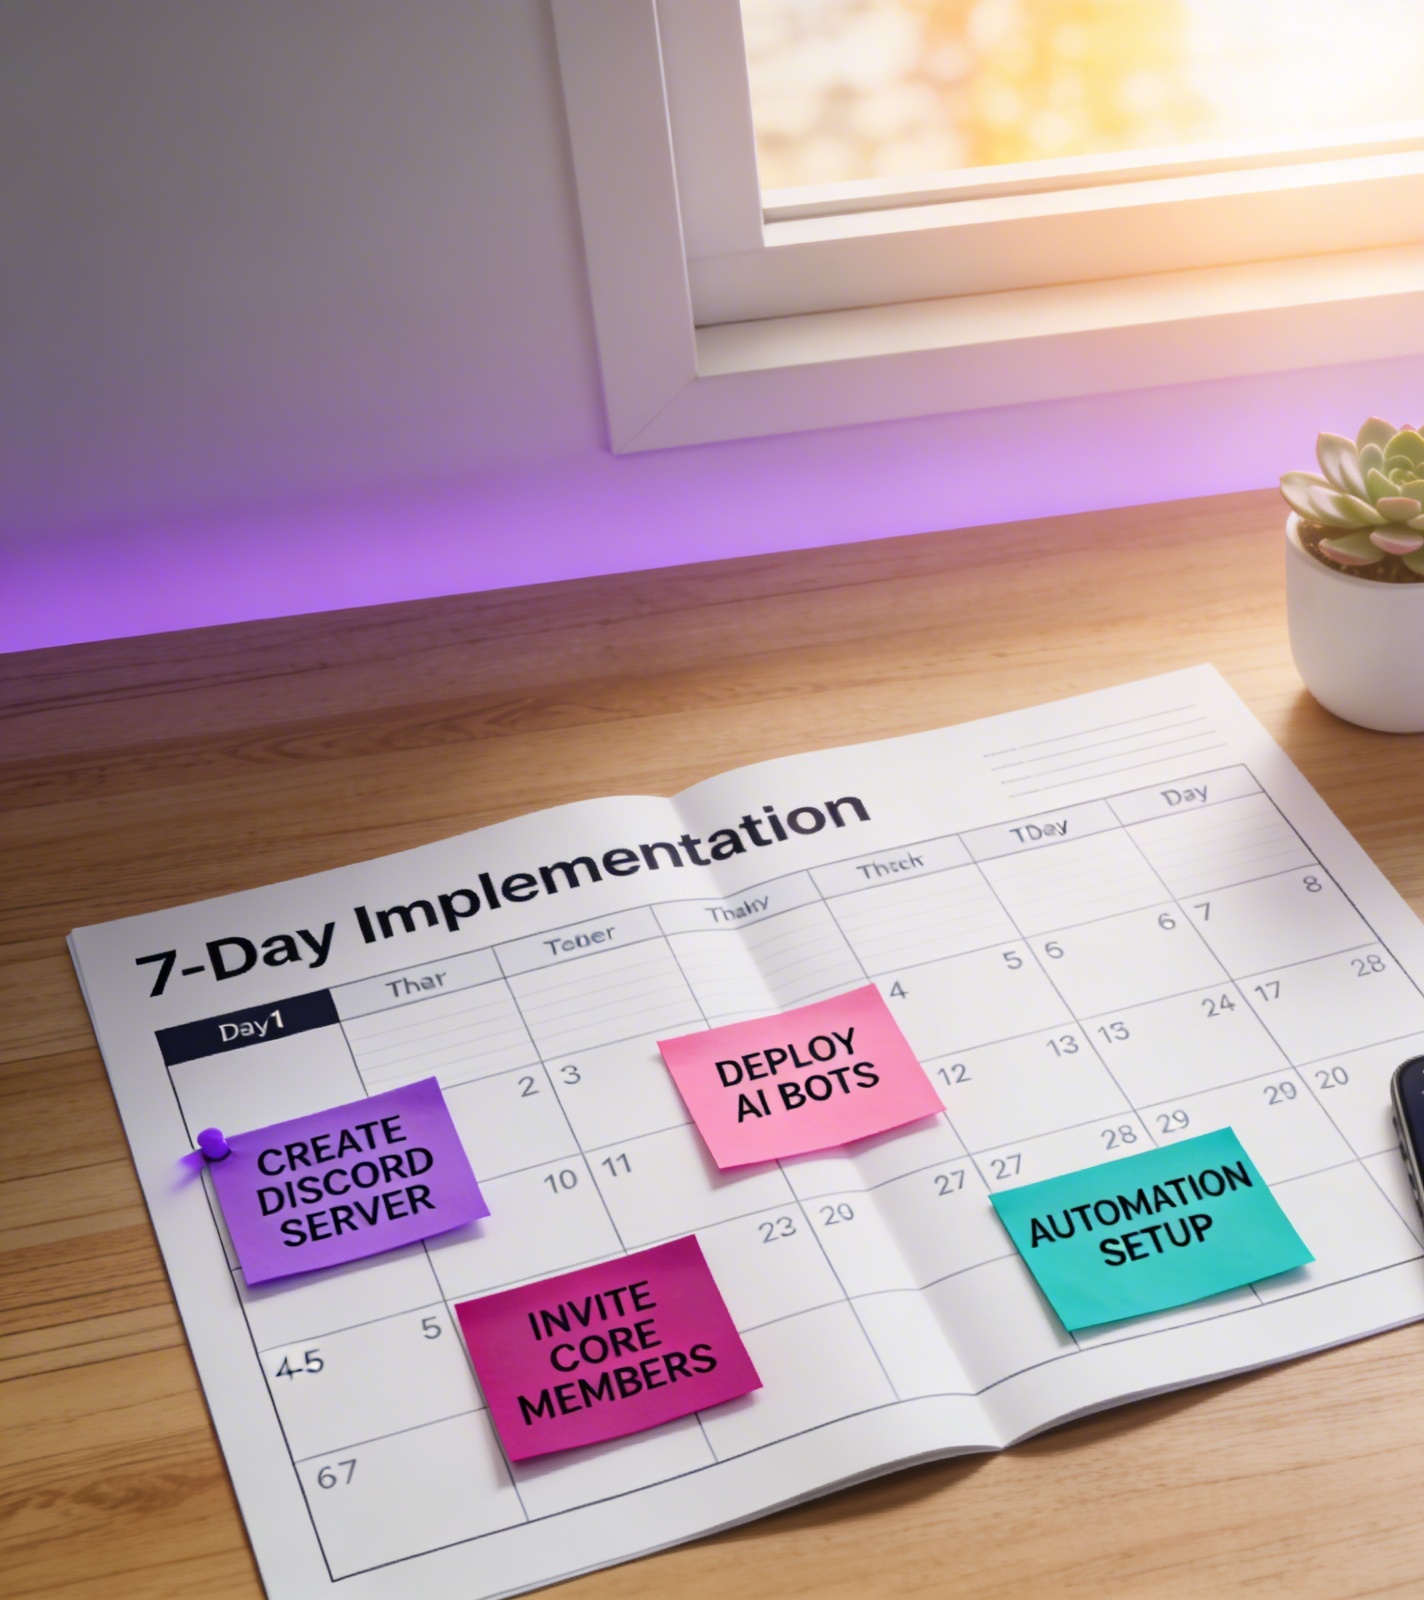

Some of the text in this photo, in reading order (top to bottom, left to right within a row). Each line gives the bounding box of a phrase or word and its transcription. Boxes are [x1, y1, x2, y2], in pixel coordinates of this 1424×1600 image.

[1160, 785, 1210, 808] Day
[1302, 876, 1323, 893] 8
[134, 796, 872, 999] 7-Day Implementation
[1157, 912, 1177, 931] 6
[1193, 902, 1212, 922] 7
[1002, 950, 1024, 971] 5
[1350, 954, 1387, 978] 28
[888, 980, 909, 999] 4
[1253, 981, 1283, 1003] 17
[1201, 993, 1236, 1018] 24
[714, 1026, 859, 1088] DEPLOY
[1046, 1035, 1080, 1057] 13
[518, 1076, 540, 1098] 2
[561, 1064, 583, 1086] 3
[936, 1064, 972, 1086] 12
[1315, 1067, 1350, 1090] 20
[734, 1059, 881, 1124] AI BOTS
[1263, 1081, 1298, 1106] 29
[1156, 1110, 1190, 1135] 29
[256, 1114, 409, 1178] CREATE
[1100, 1125, 1139, 1150] 28
[600, 1154, 633, 1178] 11
[990, 1154, 1024, 1180] 27
[255, 1146, 435, 1217] DISCORD
[543, 1169, 579, 1194] 10
[934, 1169, 967, 1196] 27
[279, 1182, 437, 1248] SERVER
[1029, 1160, 1254, 1249] AUTOMATION
[758, 1215, 799, 1244] 23
[1099, 1213, 1214, 1267] SETUP
[526, 1280, 658, 1341] INVITE
[420, 1316, 443, 1340] 5
[549, 1318, 663, 1374] CORE
[515, 1343, 718, 1427] MEMBERS
[316, 1459, 358, 1490] 67
